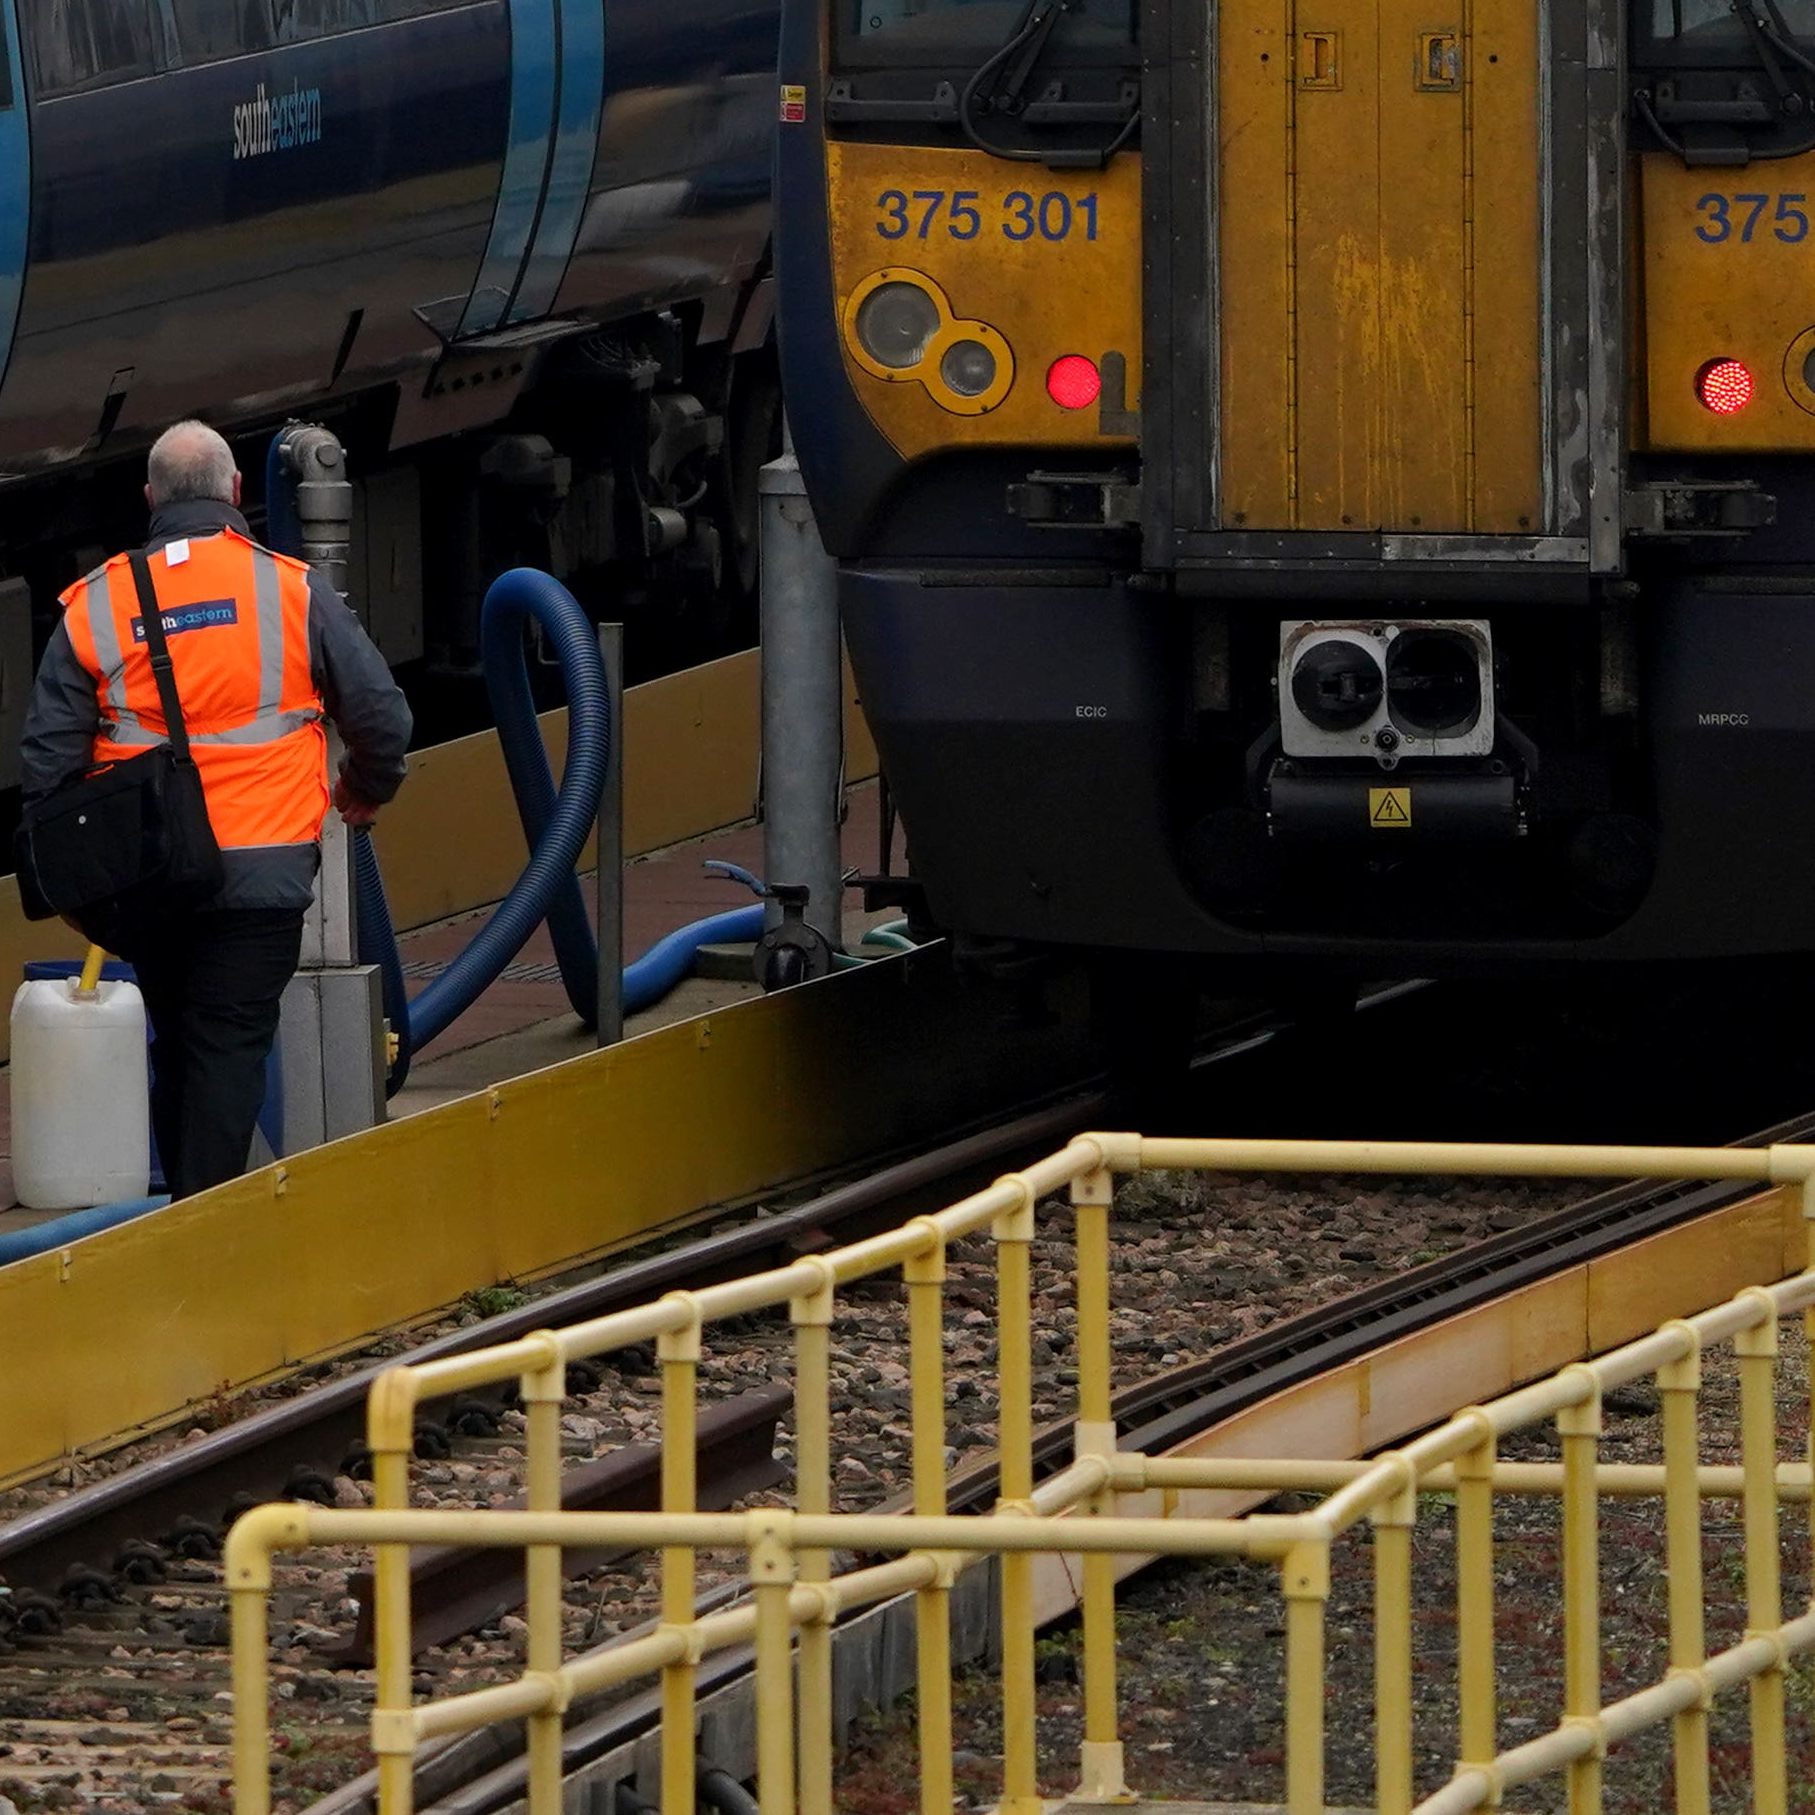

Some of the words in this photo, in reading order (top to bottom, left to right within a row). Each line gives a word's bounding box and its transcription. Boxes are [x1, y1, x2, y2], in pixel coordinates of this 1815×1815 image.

[233, 76, 321, 159] southeastern
[876, 190, 980, 241] 375
[1002, 193, 1100, 241] 301
[1695, 194, 1808, 243] 375
[135, 608, 233, 637] stheastern
[1075, 705, 1107, 718] ECIC
[1698, 713, 1750, 726] MRPCC
